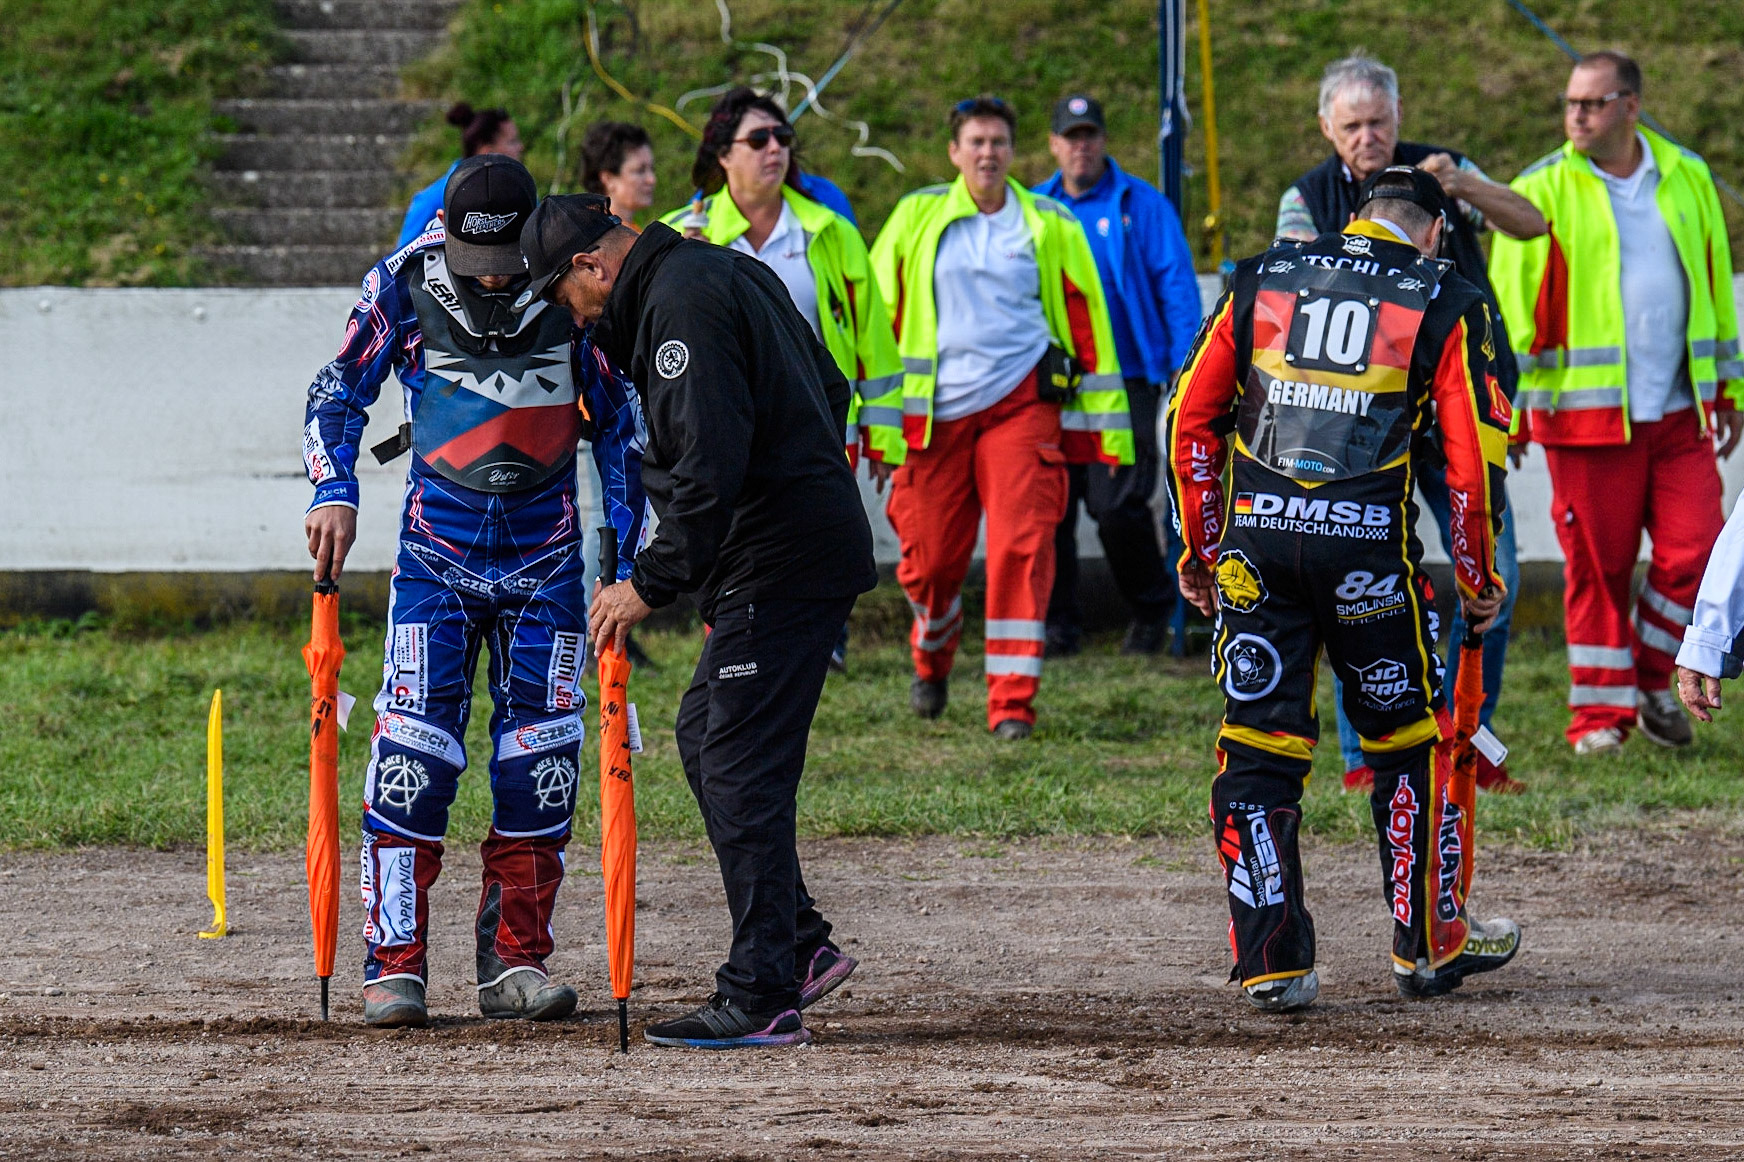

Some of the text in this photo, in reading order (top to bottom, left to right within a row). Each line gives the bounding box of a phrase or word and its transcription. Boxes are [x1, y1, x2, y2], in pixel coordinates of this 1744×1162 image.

[466, 215, 488, 229] HORSE
[1299, 297, 1371, 366] 10
[1268, 379, 1375, 417] GERMANY
[1253, 493, 1391, 526] DMSB
[1235, 515, 1365, 539] TEAM DEUTSCHLAND
[1336, 571, 1400, 600] 84
[1336, 592, 1405, 615] SMOLINSKI
[557, 634, 578, 682] profil
[719, 662, 757, 674] AUTOKLUB
[1367, 665, 1399, 681] JC
[1361, 679, 1409, 696] PRO
[391, 733, 427, 750] SPEEDWAY
[400, 724, 449, 751] CZECH
[379, 754, 430, 788] RACE WEAR
[529, 757, 552, 778] RACE
[1386, 785, 1419, 927] daytona
[1251, 856, 1265, 908] Sebastian
